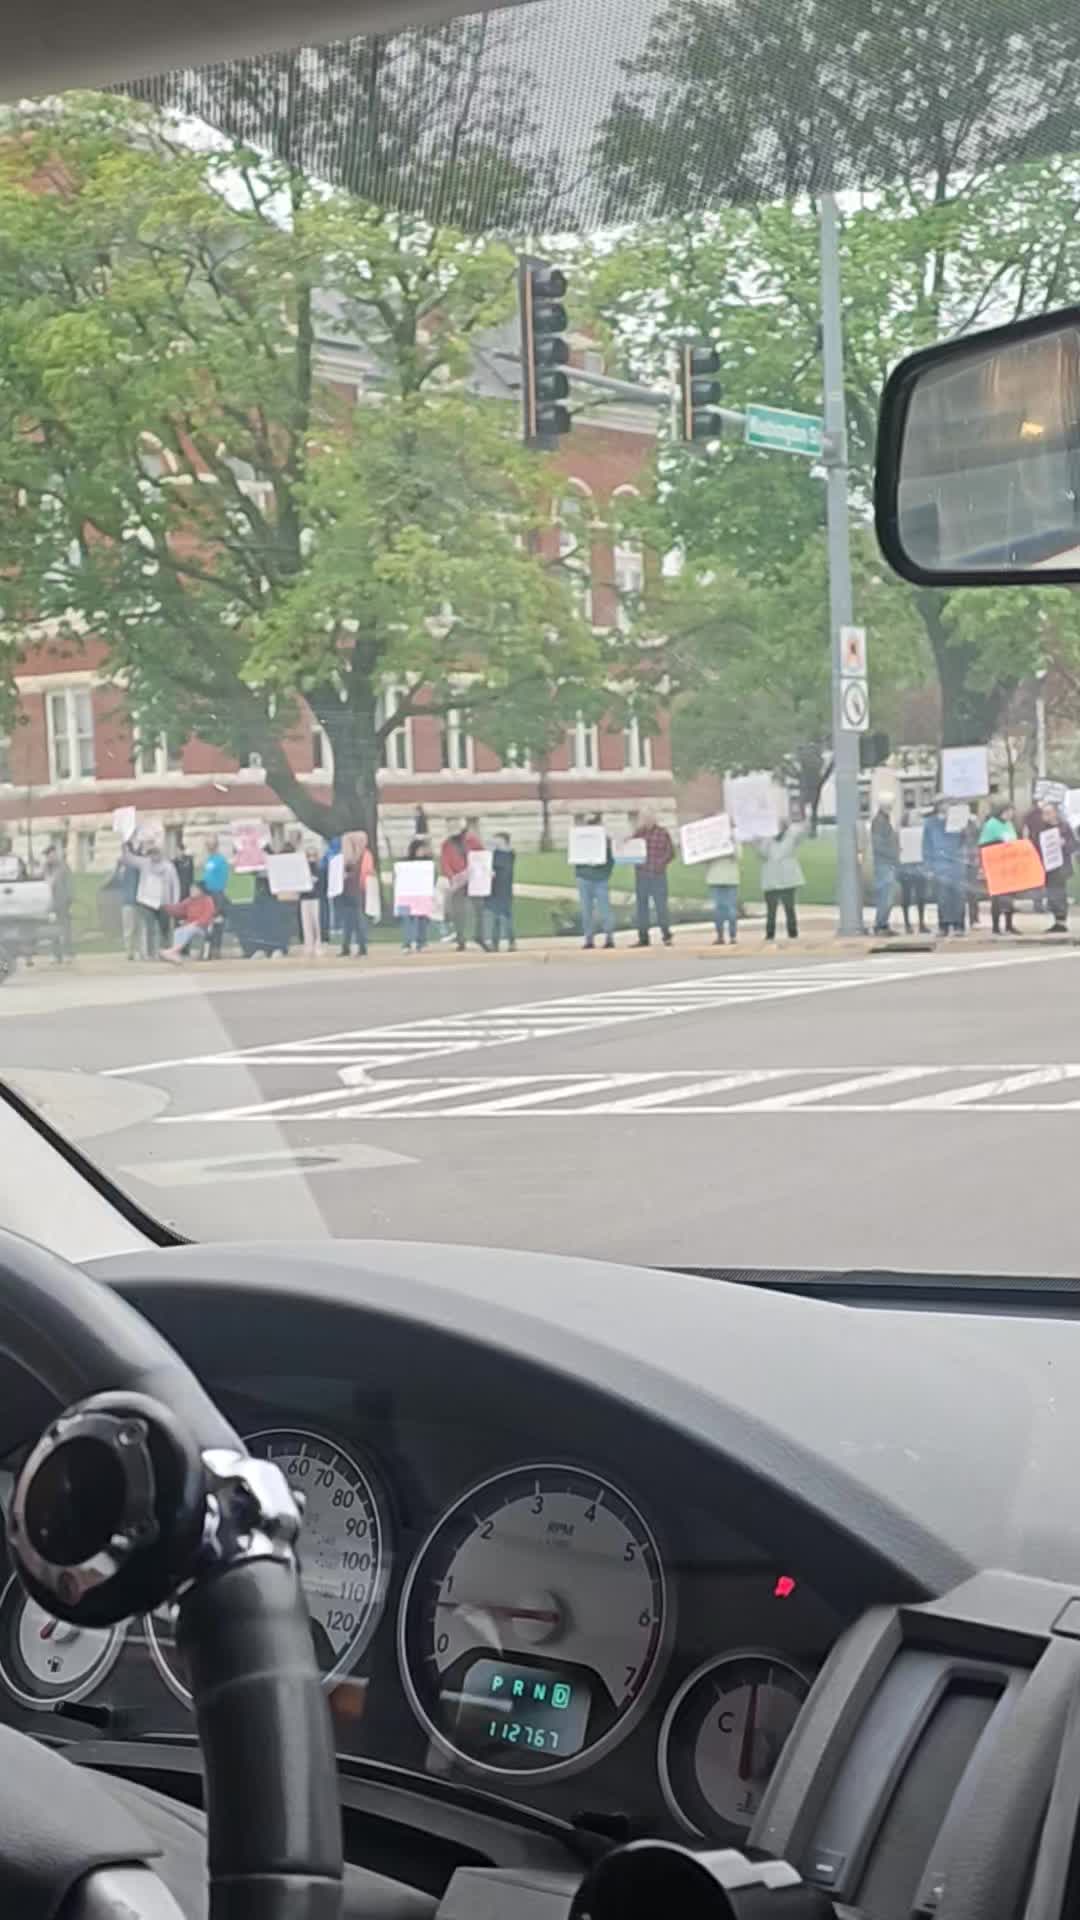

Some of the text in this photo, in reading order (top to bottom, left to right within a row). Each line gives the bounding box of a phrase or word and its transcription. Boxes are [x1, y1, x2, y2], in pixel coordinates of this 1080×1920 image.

[288, 1459, 310, 1476] 60
[314, 1468, 335, 1488] 70
[332, 1489, 354, 1508] 80
[531, 1495, 544, 1514] 3
[584, 1503, 596, 1522] 4
[345, 1518, 367, 1537] 90
[480, 1520, 494, 1540] 2
[341, 1551, 371, 1572] 100
[624, 1542, 637, 1562] 5
[340, 1582, 365, 1602] 110
[446, 1575, 454, 1593] 1
[327, 1610, 355, 1632] 120
[638, 1608, 650, 1627] 6
[437, 1633, 449, 1653] 0
[624, 1665, 637, 1687] 7
[491, 1675, 504, 1692] P
[513, 1679, 525, 1697] R
[533, 1683, 547, 1701] N
[718, 1711, 735, 1733] C
[489, 1720, 559, 1749] 112767
